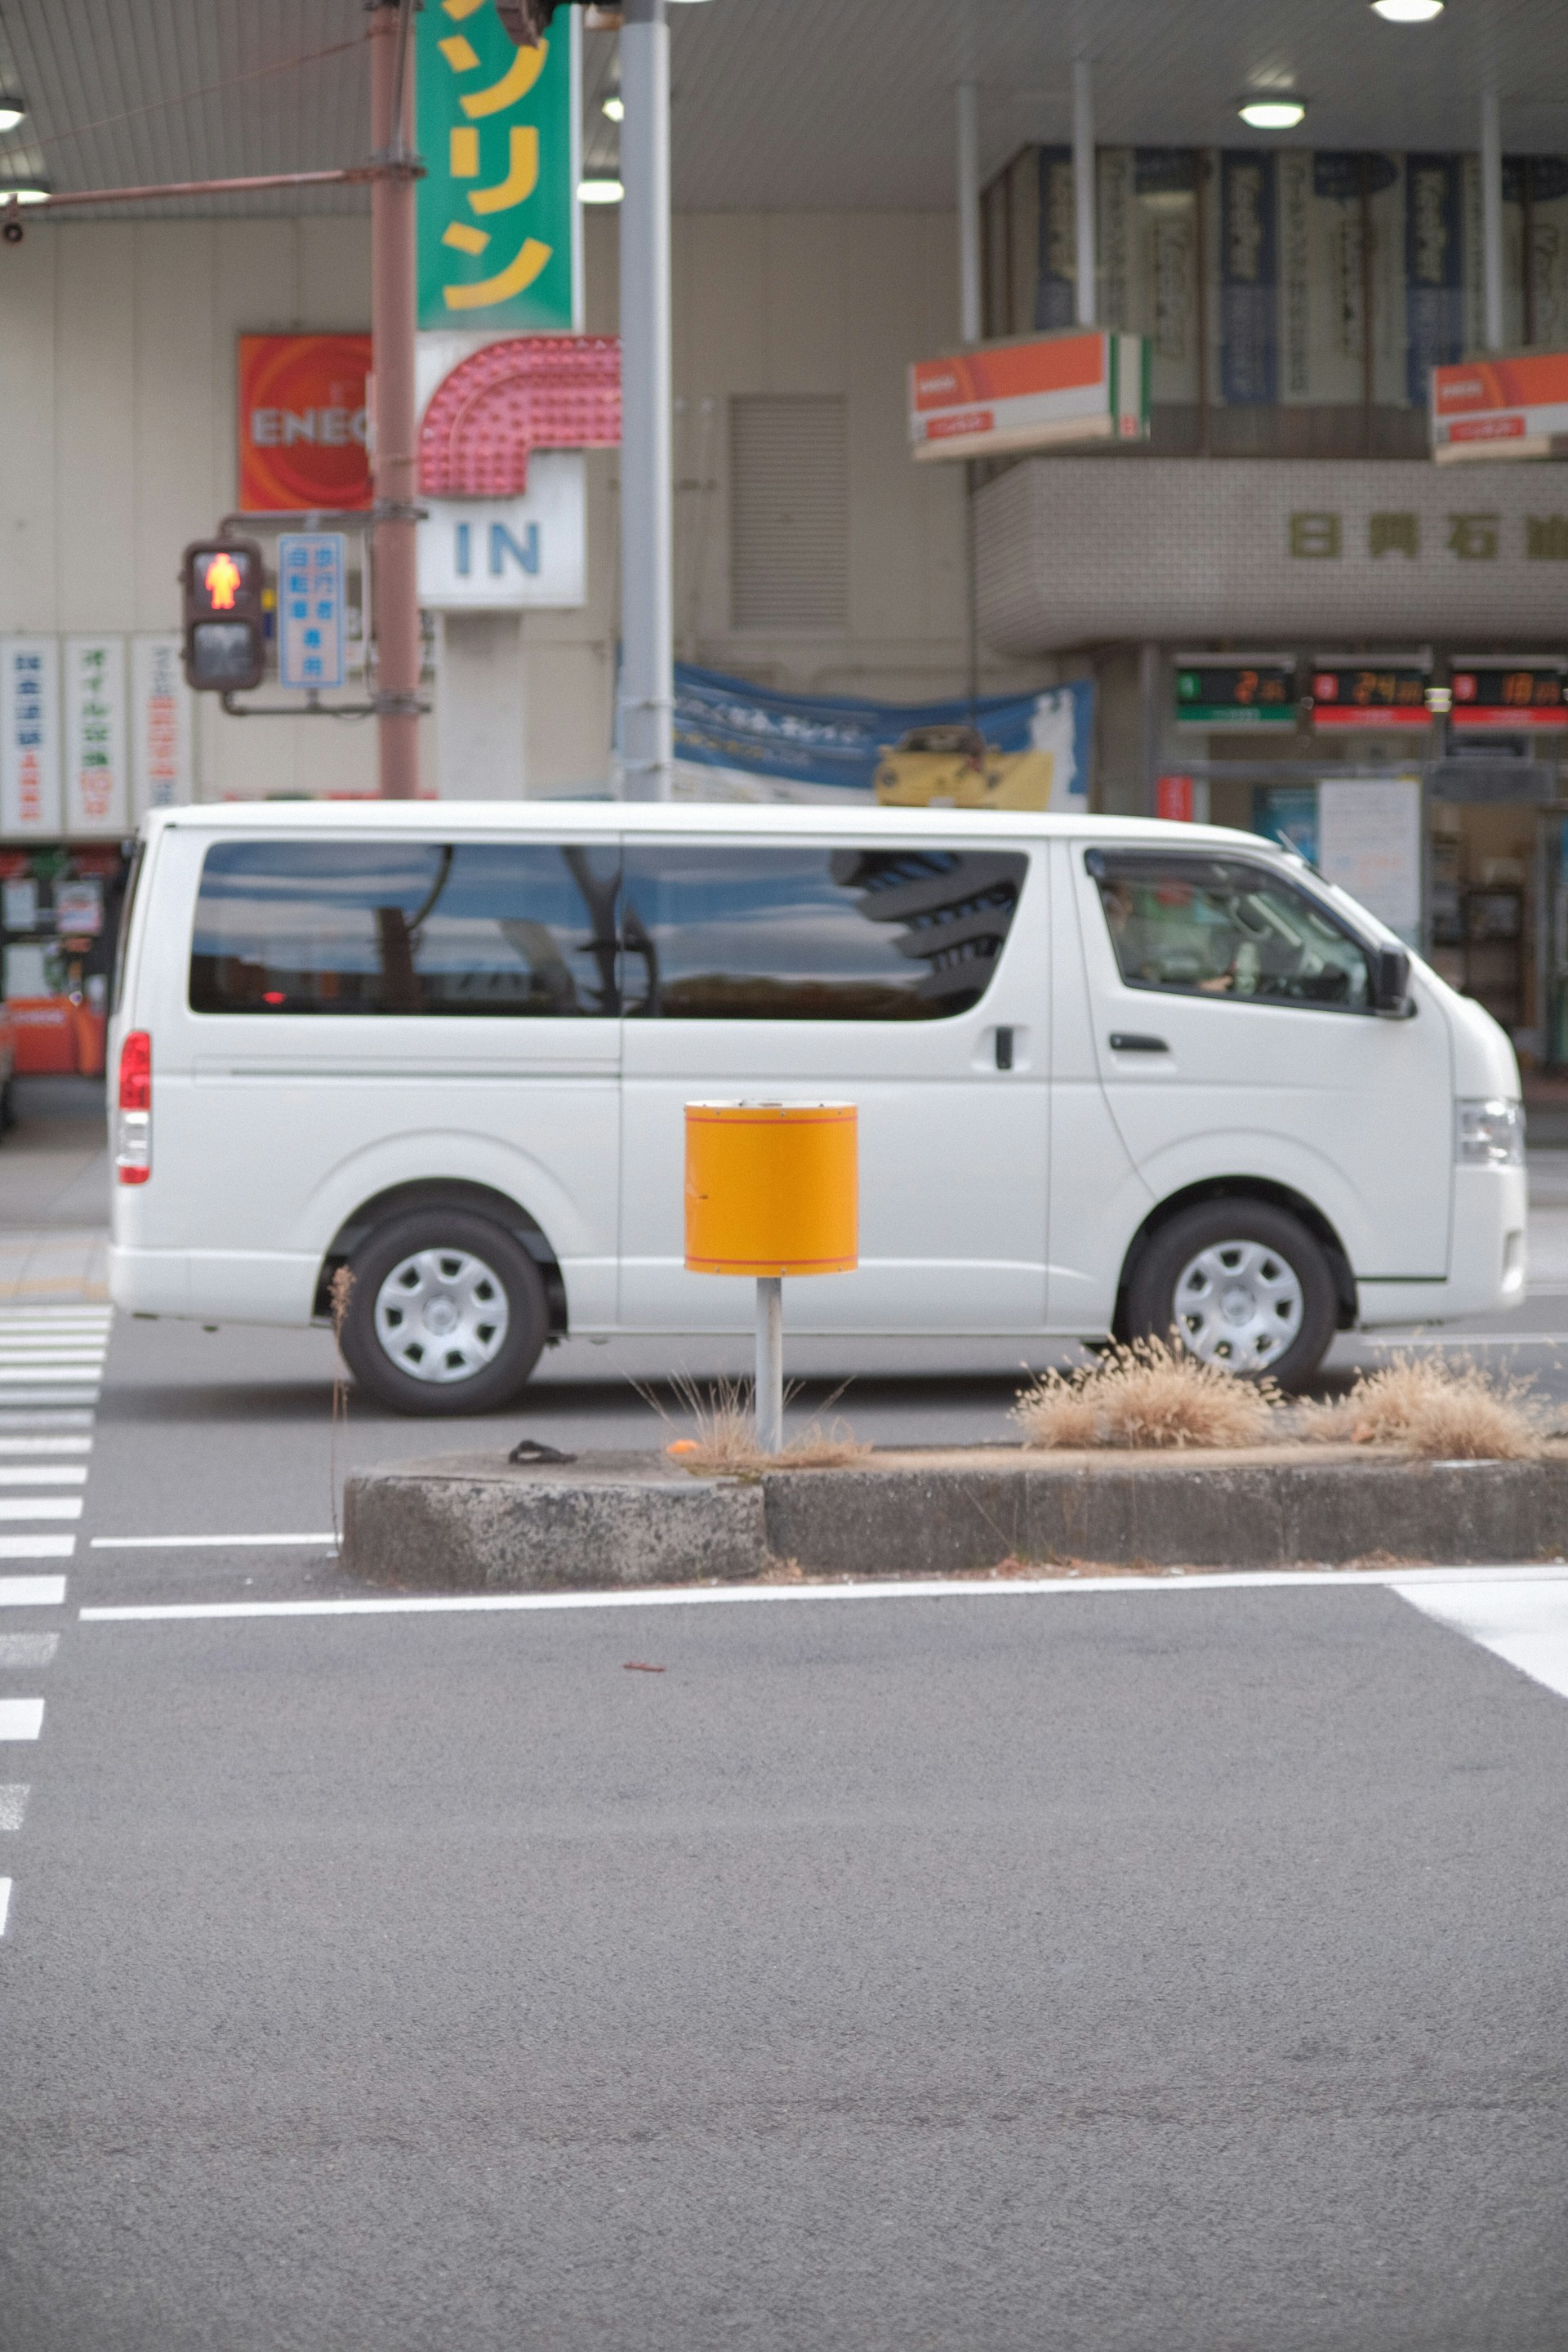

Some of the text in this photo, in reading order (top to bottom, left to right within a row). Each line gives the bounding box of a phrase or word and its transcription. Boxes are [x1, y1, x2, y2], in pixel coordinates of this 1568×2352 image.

[439, 0, 553, 310] ソリン
[252, 408, 368, 446] ENE
[456, 523, 539, 577] IN
